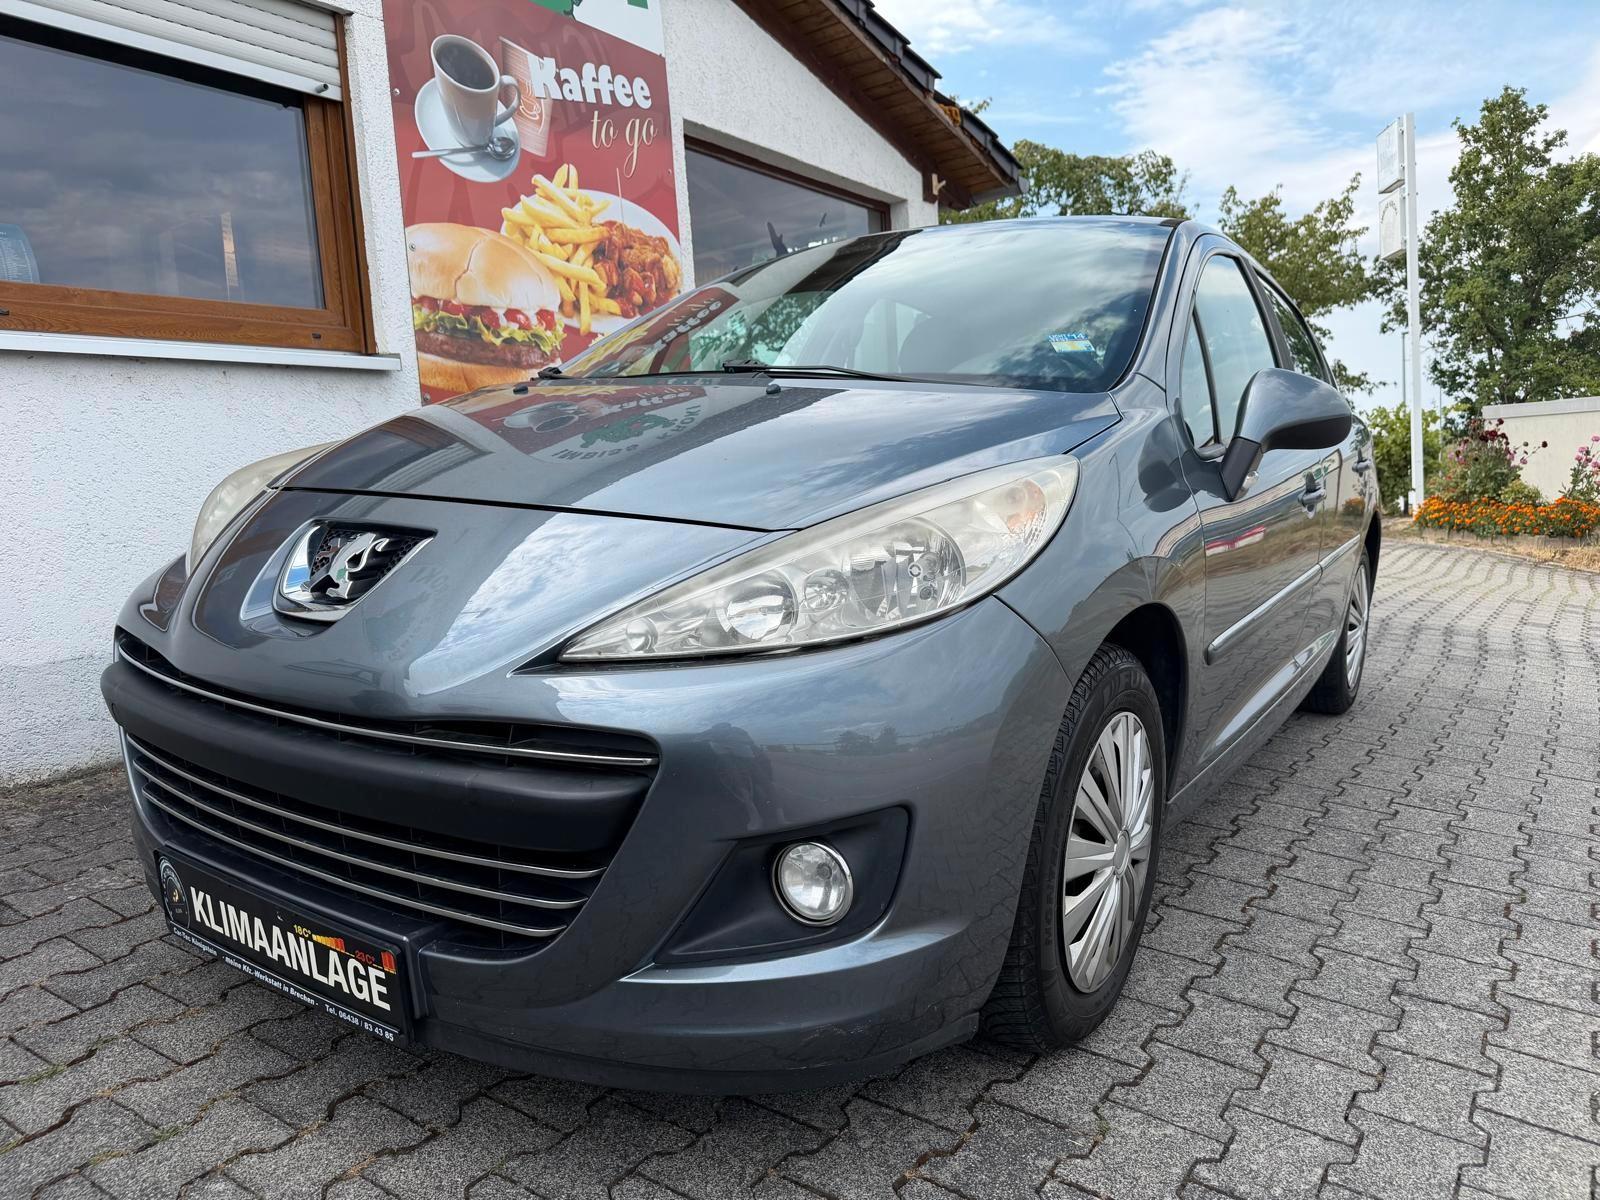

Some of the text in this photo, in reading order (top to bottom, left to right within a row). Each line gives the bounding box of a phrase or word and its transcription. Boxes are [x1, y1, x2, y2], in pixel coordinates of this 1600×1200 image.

[527, 56, 652, 109] Kaffee
[591, 110, 658, 178] to go
[190, 886, 391, 1011] KLIMAANLAGE
[225, 957, 241, 970] meine
[283, 984, 289, 993] in
[290, 987, 315, 1006] Brechen
[325, 1004, 337, 1017] Tel.
[338, 1010, 359, 1026] 06438
[364, 1021, 373, 1032] 83
[374, 1026, 384, 1037] 43
[384, 1032, 394, 1042] 85
